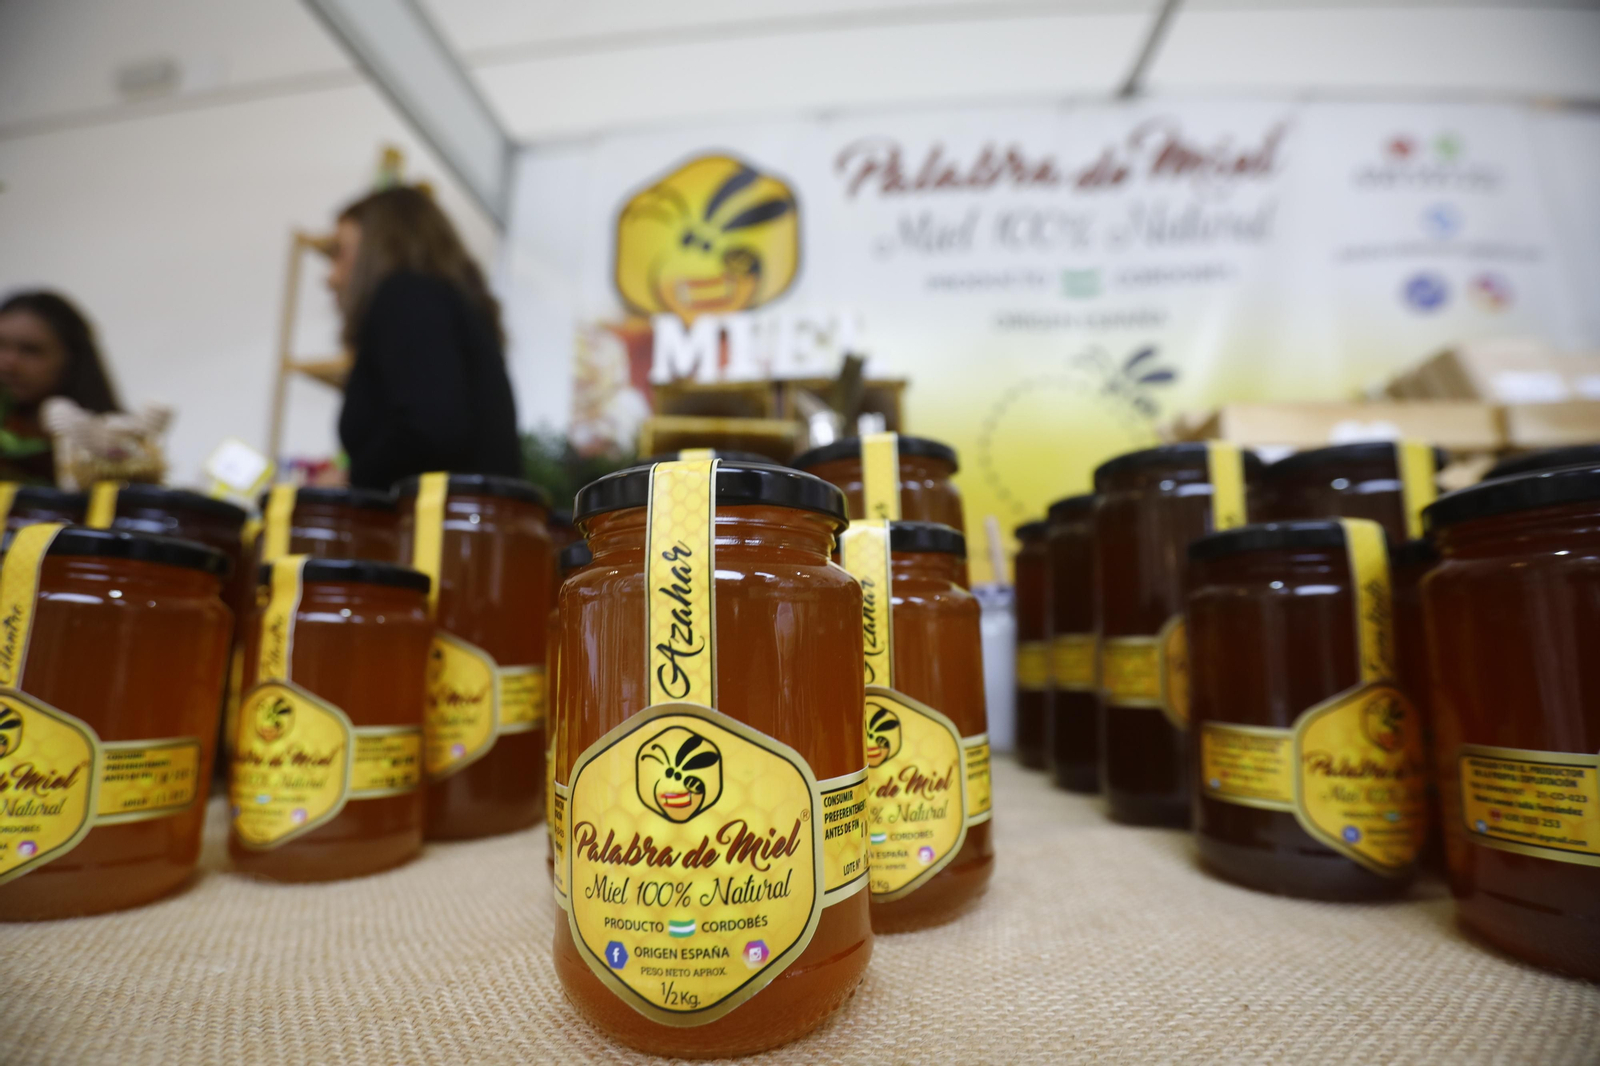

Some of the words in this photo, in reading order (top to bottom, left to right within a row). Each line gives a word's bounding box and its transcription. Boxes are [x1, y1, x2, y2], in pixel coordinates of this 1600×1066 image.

[833, 134, 1062, 202] Palabra
[1125, 115, 1294, 203] Miel
[655, 539, 706, 699] Azahar
[10, 762, 82, 798] Miel
[876, 776, 900, 798] de
[898, 765, 953, 801] Miel
[0, 797, 68, 818] Natural
[824, 790, 853, 807] CONSUMIR
[888, 800, 949, 824] Natural
[825, 825, 844, 840] ANTES
[844, 821, 852, 834] DE
[574, 820, 681, 868] Palabra
[682, 835, 720, 869] de
[716, 818, 801, 872] Miel
[843, 860, 856, 876] LOTE
[585, 873, 630, 905] Miel
[636, 881, 693, 907] 100%
[700, 868, 792, 906] Natural
[604, 917, 664, 932] PRODUCTO
[701, 915, 768, 932] CORDOBÉS
[634, 946, 677, 960] ORIGEN
[681, 945, 730, 960] ESPAÑA
[640, 966, 664, 976] PESO
[665, 968, 691, 977] NETO
